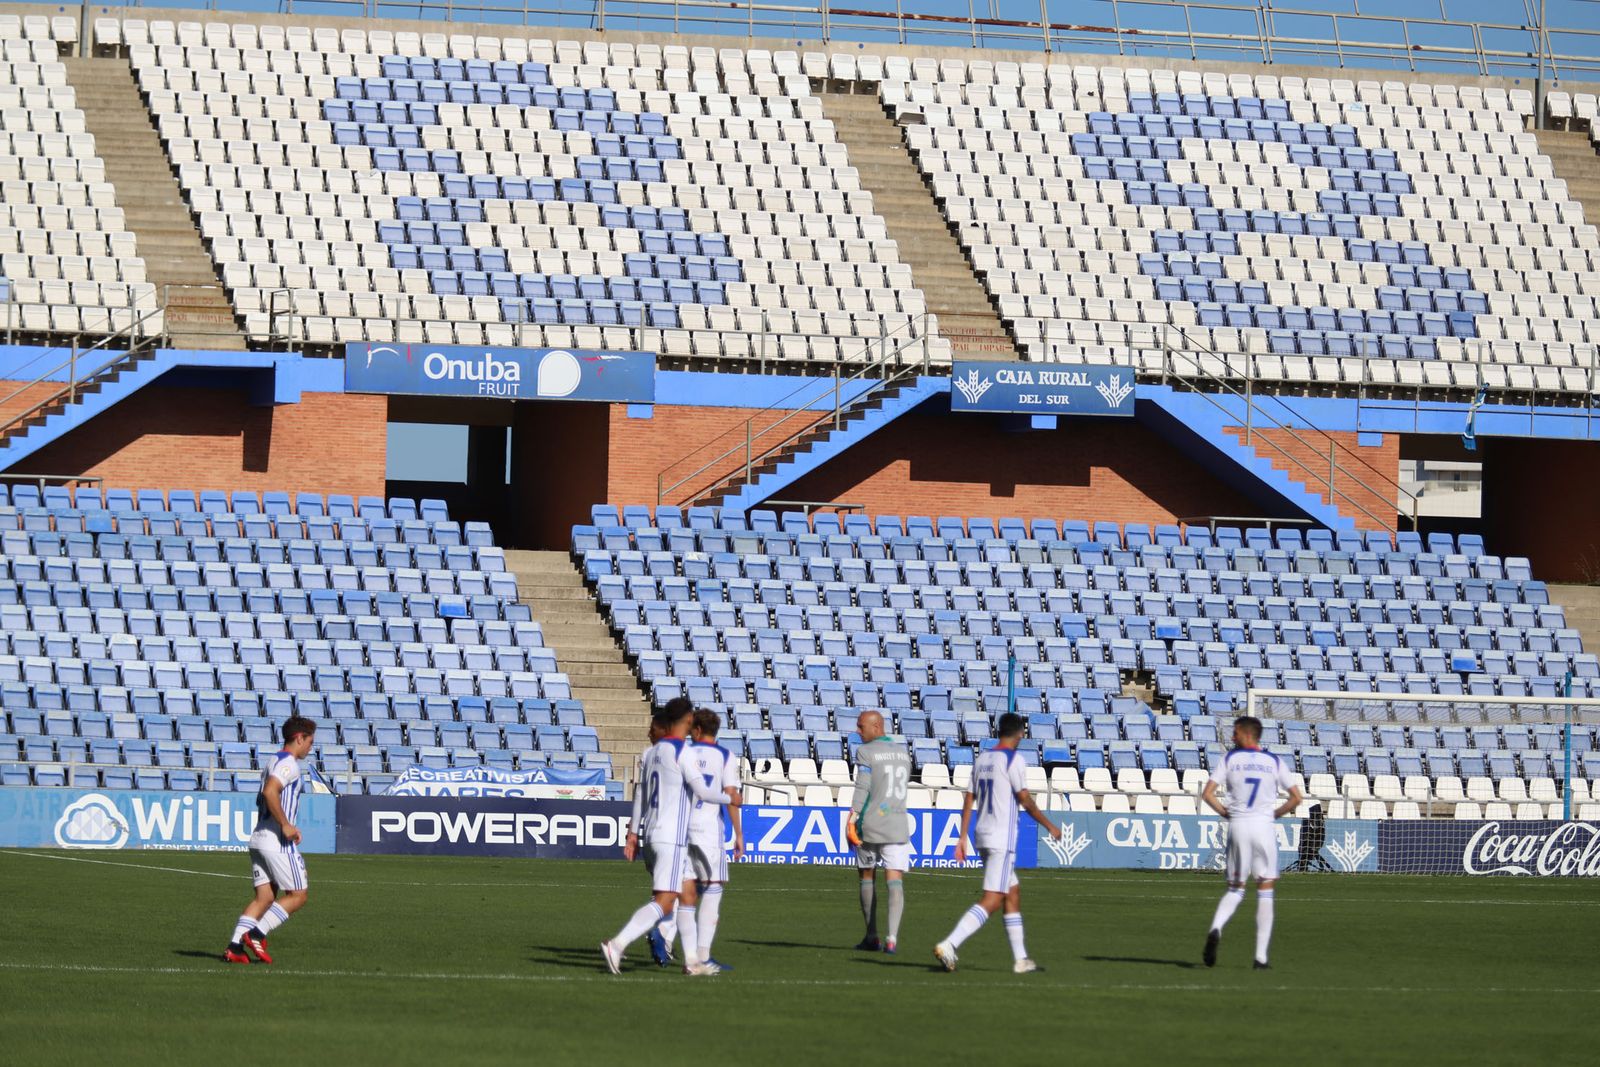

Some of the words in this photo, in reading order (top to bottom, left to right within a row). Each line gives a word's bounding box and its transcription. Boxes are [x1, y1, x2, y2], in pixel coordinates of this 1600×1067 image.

[423, 352, 520, 381] Onuba
[995, 369, 1034, 386] CAJA
[1039, 371, 1092, 387] RURAL
[478, 382, 520, 396] FRUIT
[1018, 394, 1042, 404] DEL
[1046, 395, 1070, 405] SUR
[399, 767, 549, 785] RECREATIVISTA
[884, 765, 908, 800] 13
[1244, 777, 1262, 808] 7
[1106, 817, 1189, 851] CAJA
